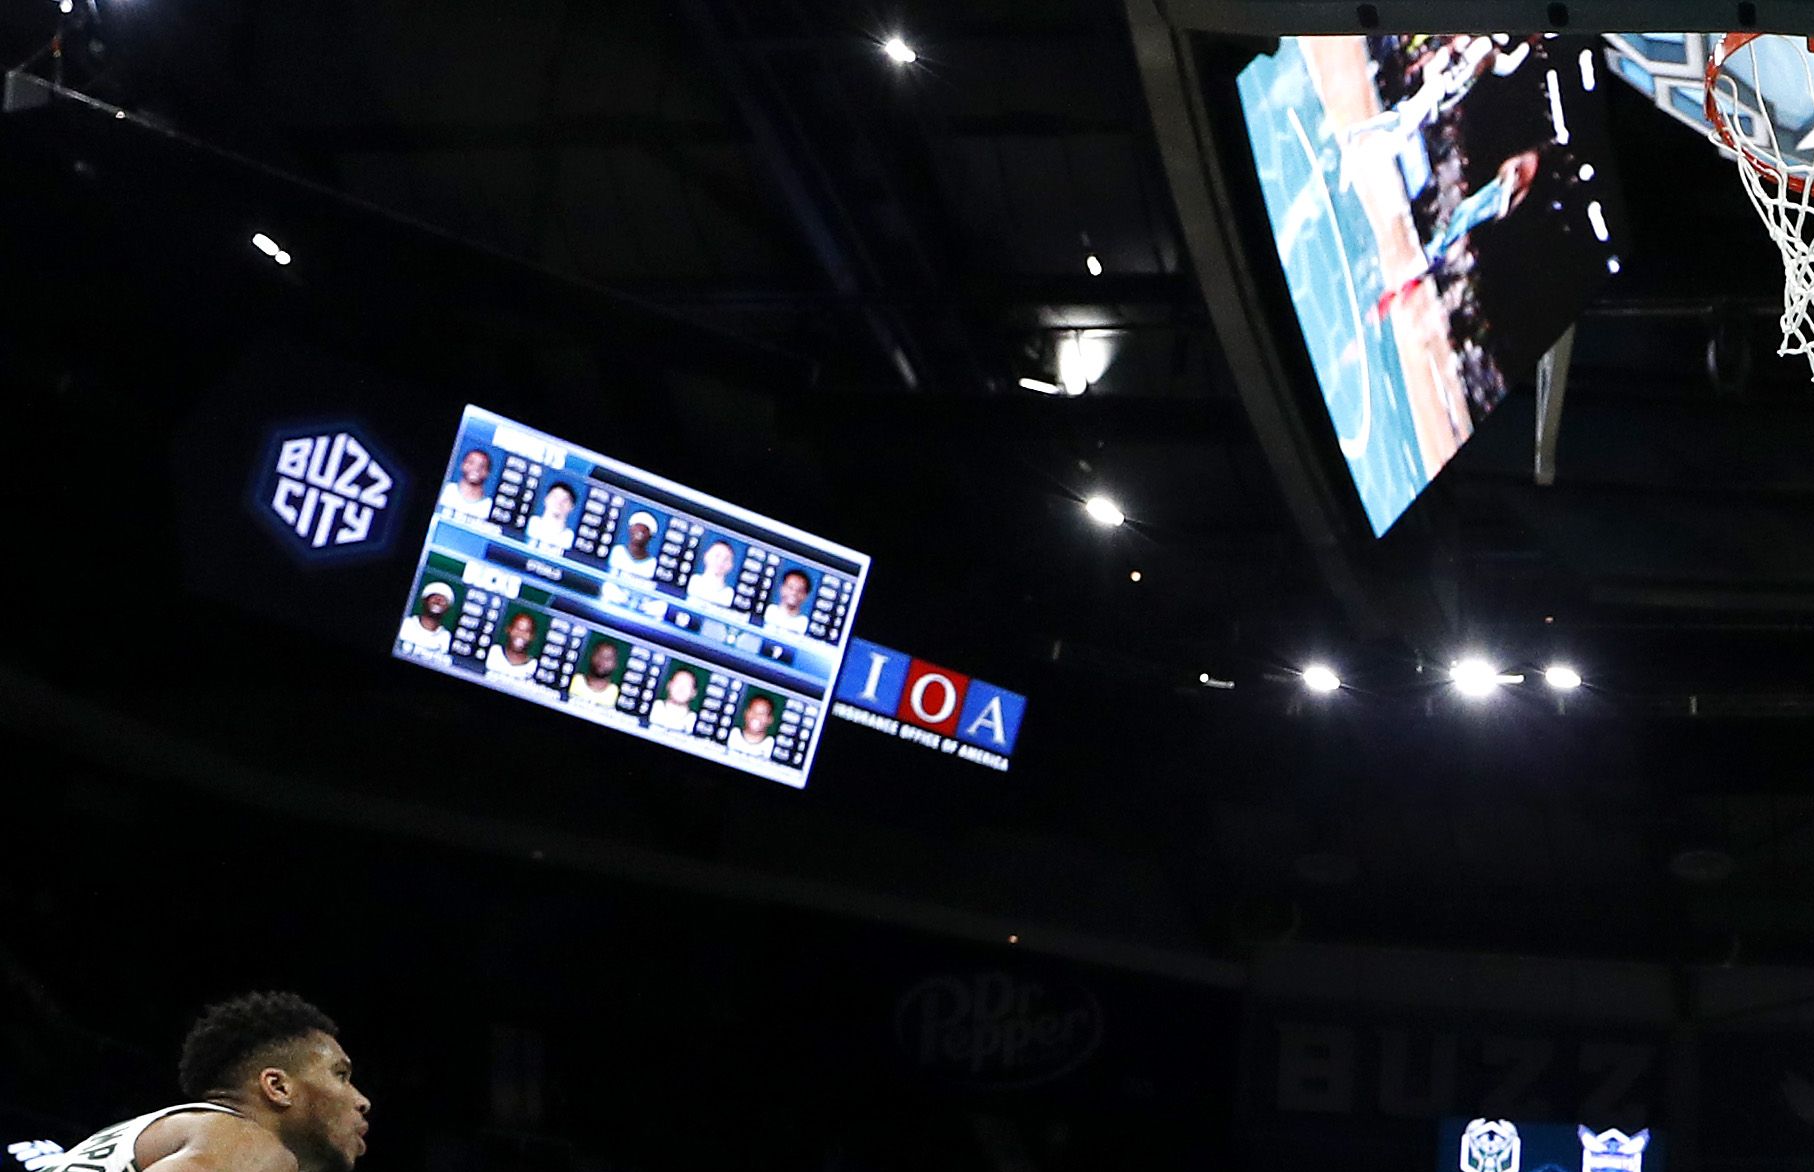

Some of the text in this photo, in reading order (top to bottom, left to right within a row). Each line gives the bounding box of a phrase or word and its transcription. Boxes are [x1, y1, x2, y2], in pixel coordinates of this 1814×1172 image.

[276, 433, 393, 509] BUZZ
[272, 476, 374, 548] CITY
[958, 744, 1008, 772] AMERICA
